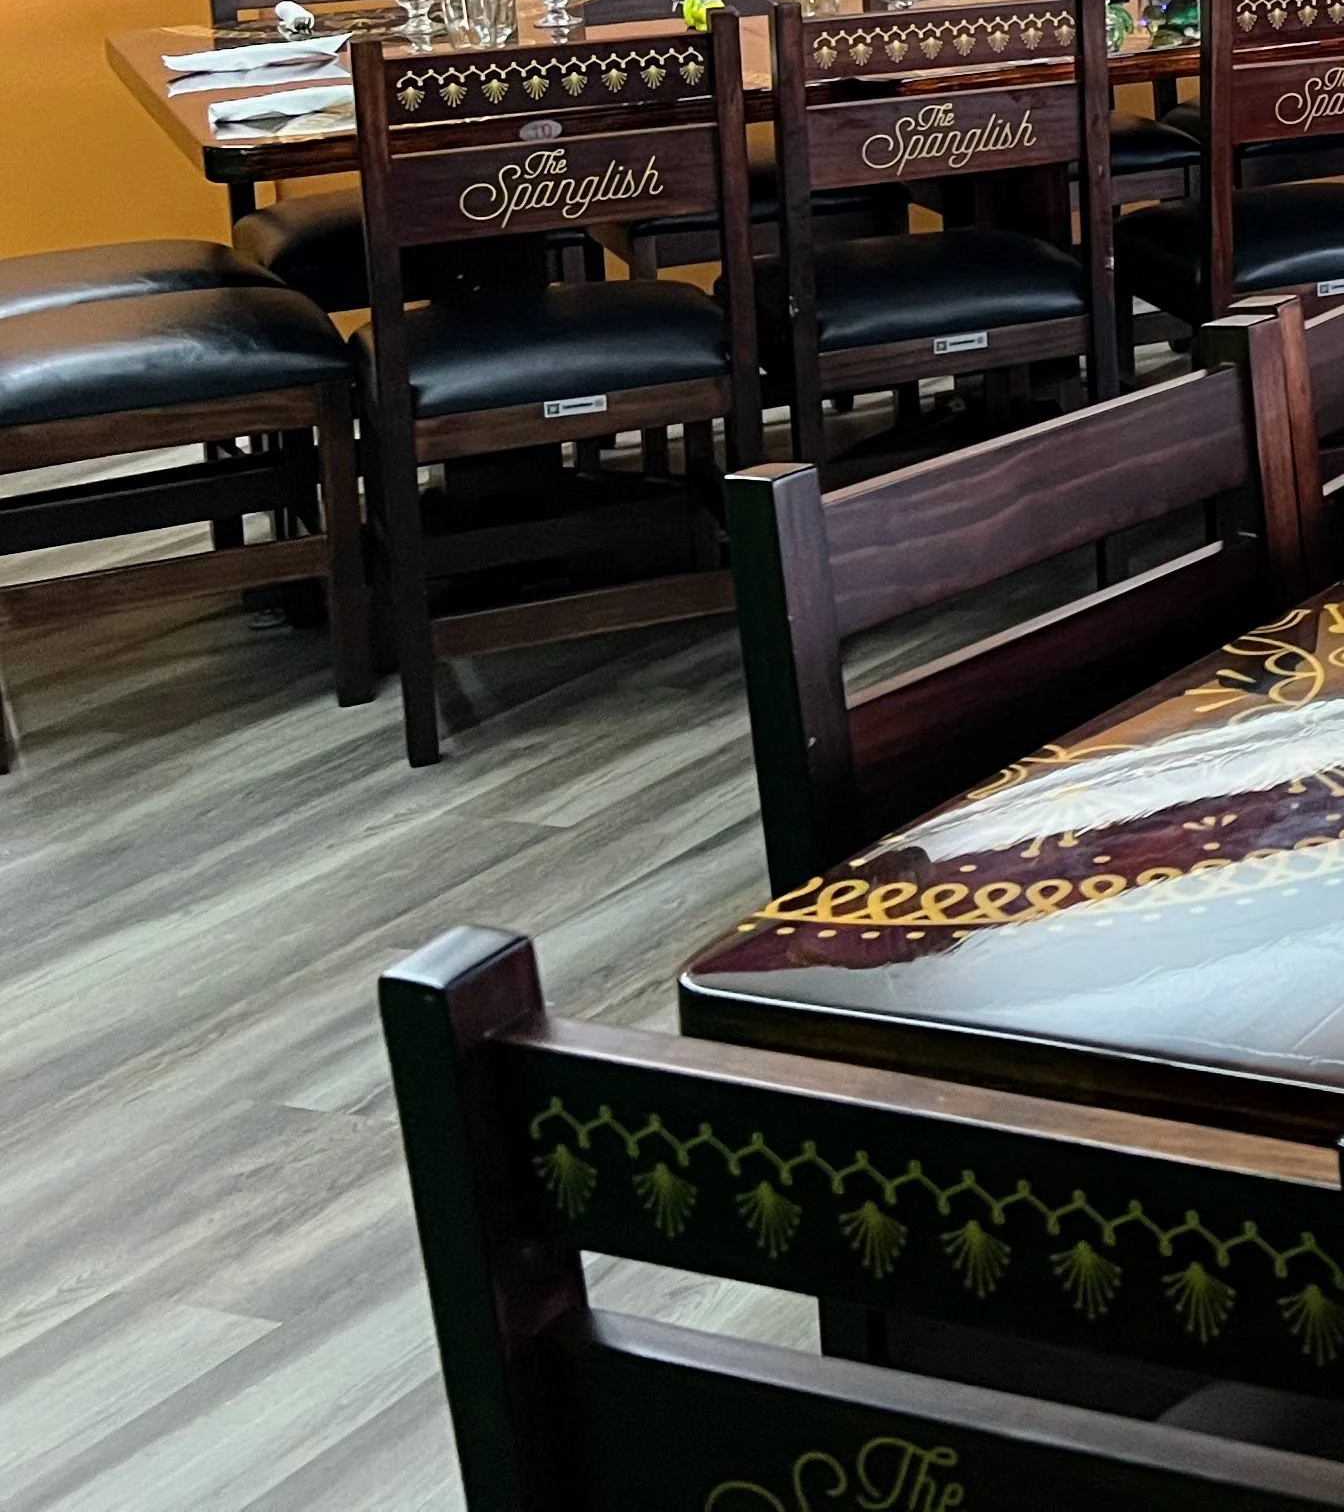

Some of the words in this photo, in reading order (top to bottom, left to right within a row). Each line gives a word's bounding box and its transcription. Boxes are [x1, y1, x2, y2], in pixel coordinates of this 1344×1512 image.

[916, 102, 955, 131] The
[523, 148, 568, 180] The
[861, 109, 1037, 176] Spanglish
[459, 155, 664, 229] Spanglish
